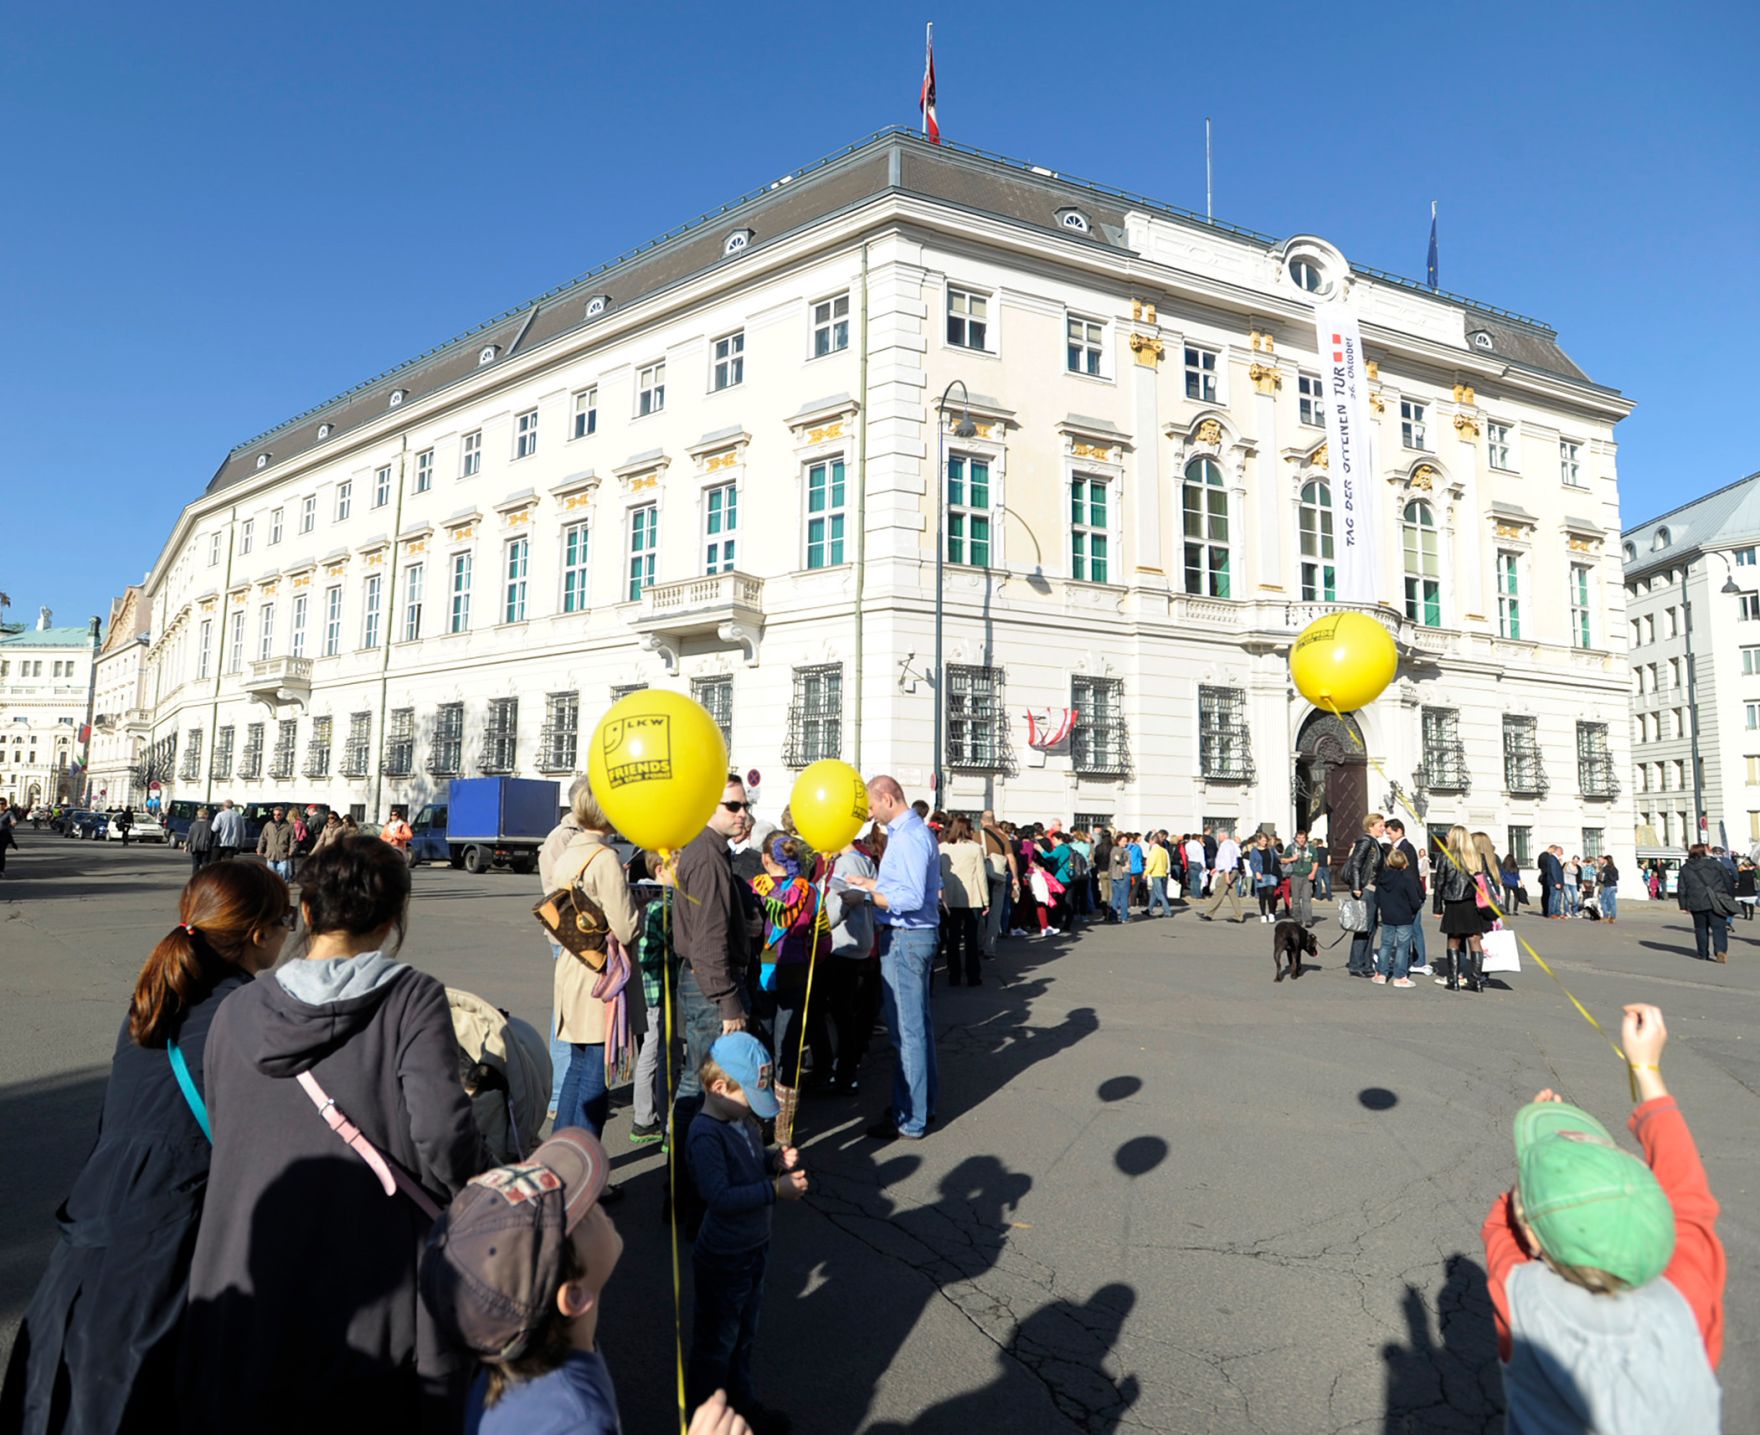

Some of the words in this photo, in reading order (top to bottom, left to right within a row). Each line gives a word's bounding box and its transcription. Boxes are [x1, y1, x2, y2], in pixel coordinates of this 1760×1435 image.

[1345, 336, 1354, 379] Oktober
[1337, 404, 1351, 474] OFFENEN
[1344, 479, 1353, 511] DER
[1345, 517, 1355, 547] TAG
[627, 719, 664, 728] LKW
[608, 761, 670, 781] FRIENDS
